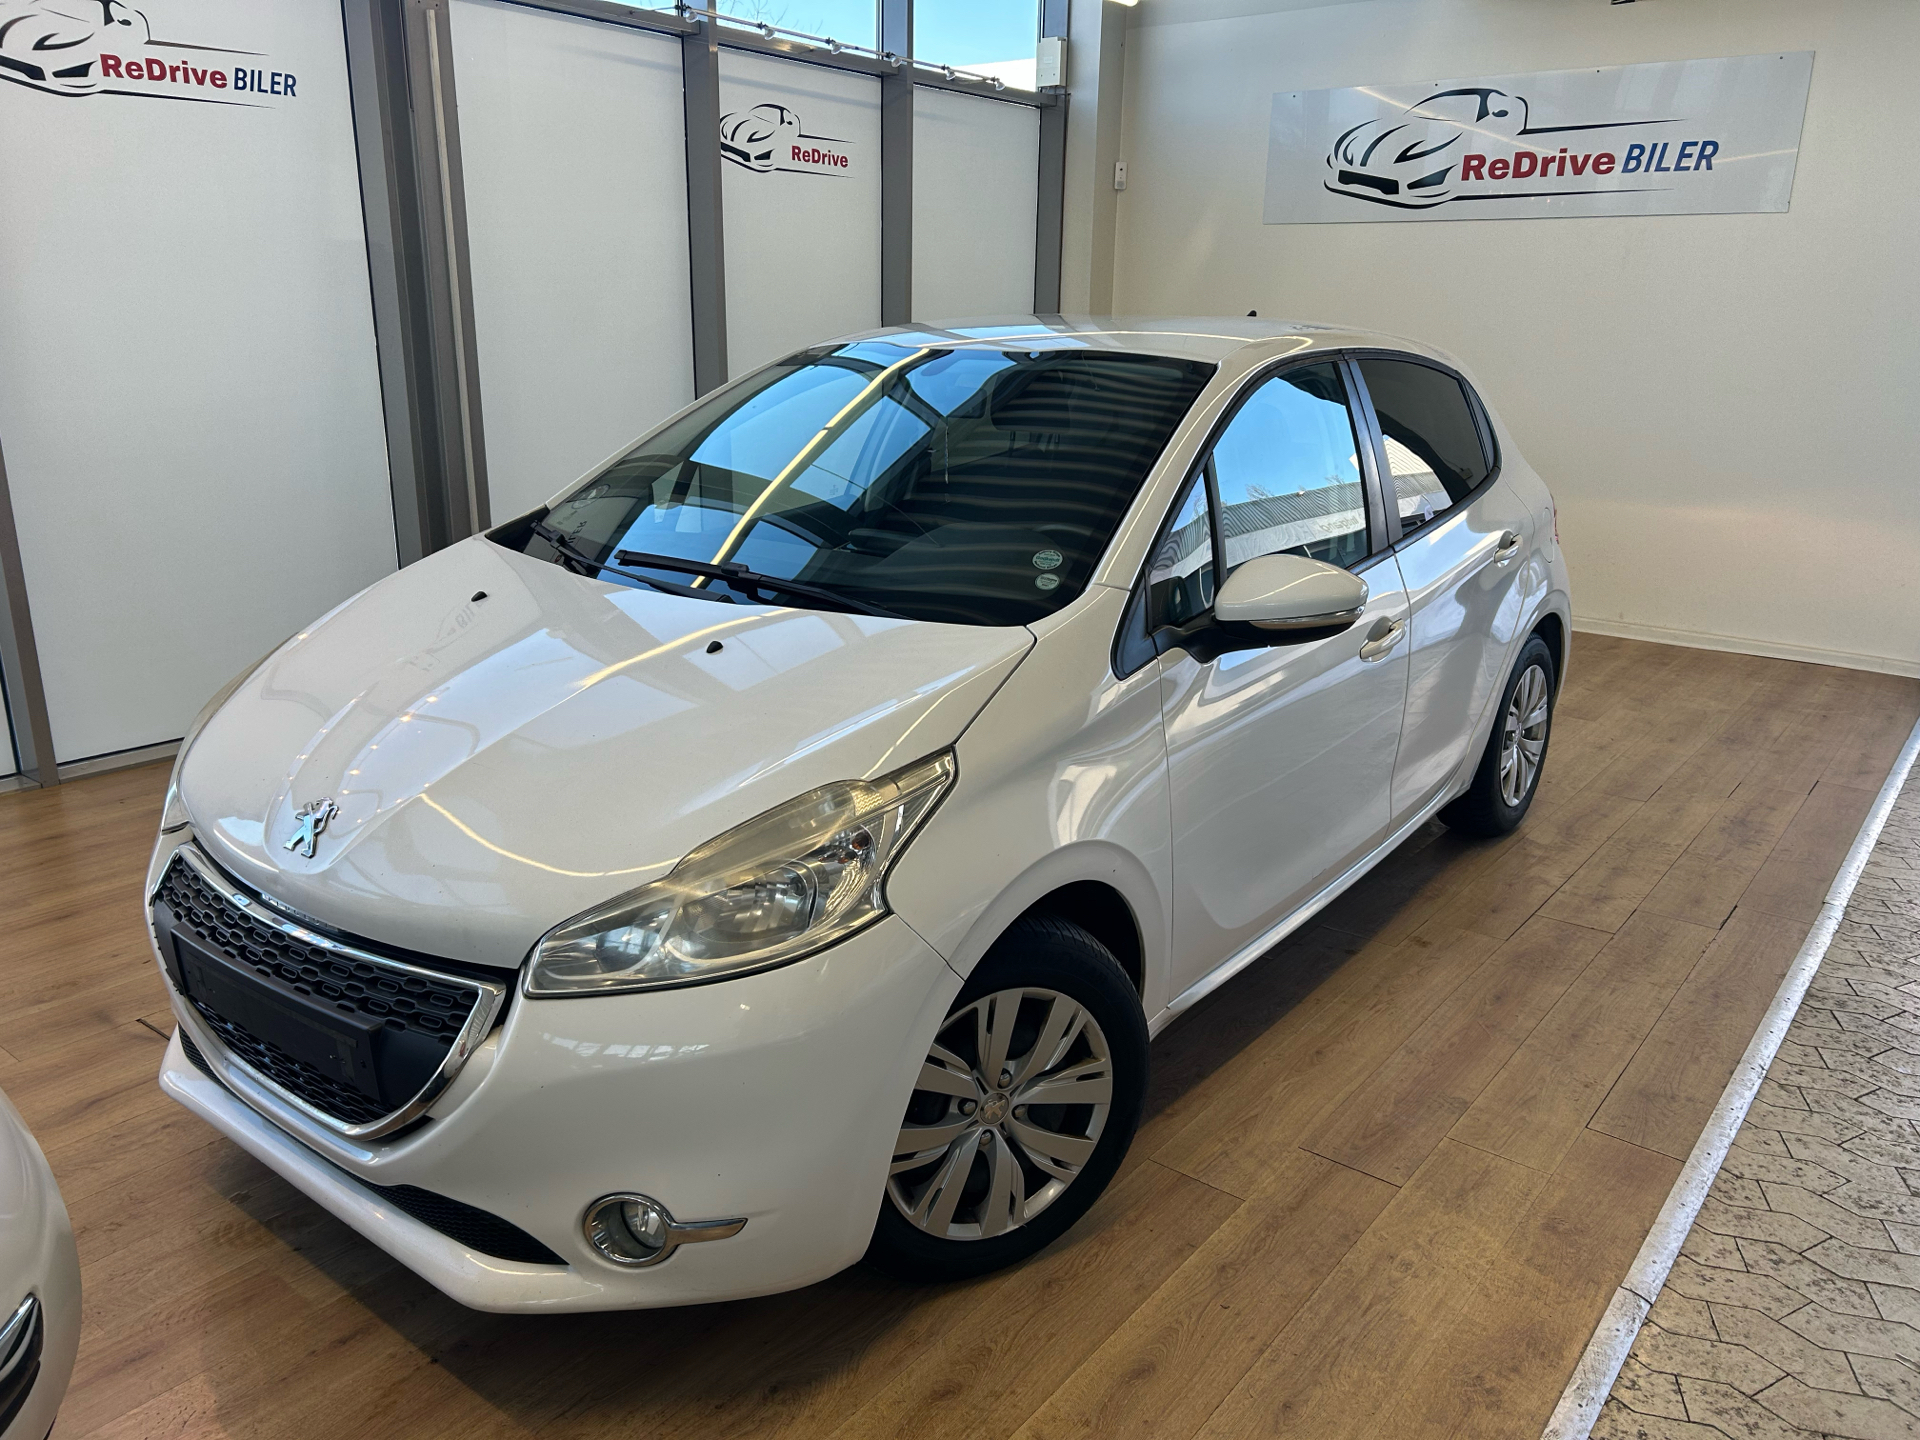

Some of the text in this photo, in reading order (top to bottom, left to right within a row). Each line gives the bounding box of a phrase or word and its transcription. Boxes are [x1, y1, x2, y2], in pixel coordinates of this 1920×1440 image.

[100, 53, 297, 97] ReDrive BILER
[791, 145, 849, 168] ReDrive
[1461, 140, 1720, 181] ReDrive BILER
